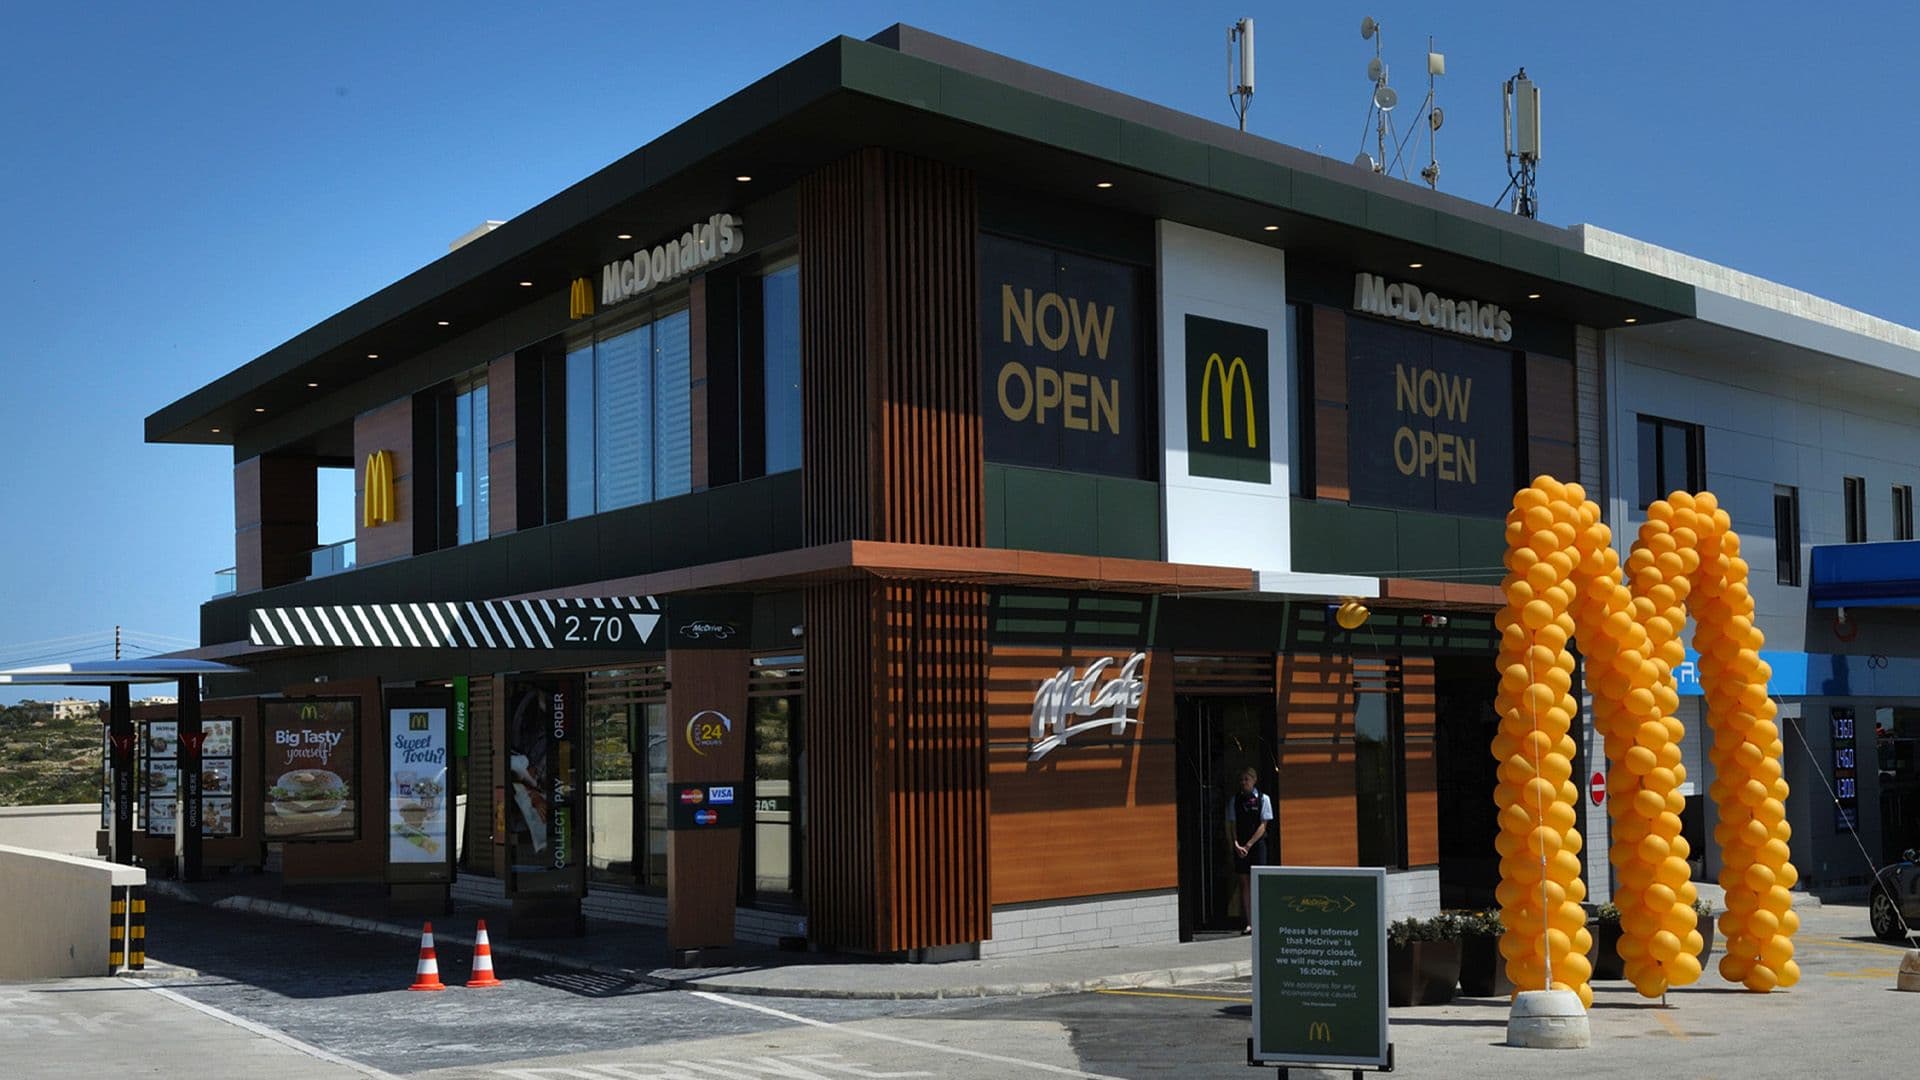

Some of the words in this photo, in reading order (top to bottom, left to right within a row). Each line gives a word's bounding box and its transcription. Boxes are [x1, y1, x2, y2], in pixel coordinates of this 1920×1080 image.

[601, 212, 744, 306] McDonald's
[1354, 271, 1513, 343] McDonald's
[1002, 284, 1115, 360] NOW
[997, 361, 1121, 436] OPEN
[1395, 363, 1473, 423] NOW
[1393, 426, 1478, 485] OPEN
[564, 615, 624, 644] 2.70
[692, 623, 723, 633] McDrive
[456, 701, 465, 732] NEWS
[554, 693, 565, 738] ORDER
[275, 730, 300, 745] Big
[302, 730, 342, 746] Tasty
[395, 735, 432, 751] Sweet
[701, 723, 722, 740] 24
[402, 747, 446, 764] Tooth?
[554, 778, 565, 803] PAY
[711, 789, 733, 798] VISA
[554, 809, 565, 869] COLLECT
[1279, 926, 1305, 935] Please
[1307, 927, 1319, 935] be
[1286, 937, 1303, 945] that
[1344, 938, 1352, 946] is
[1281, 947, 1324, 956] temporary
[1326, 948, 1357, 957] closed,
[1290, 957, 1305, 965] will
[1341, 959, 1362, 967] after
